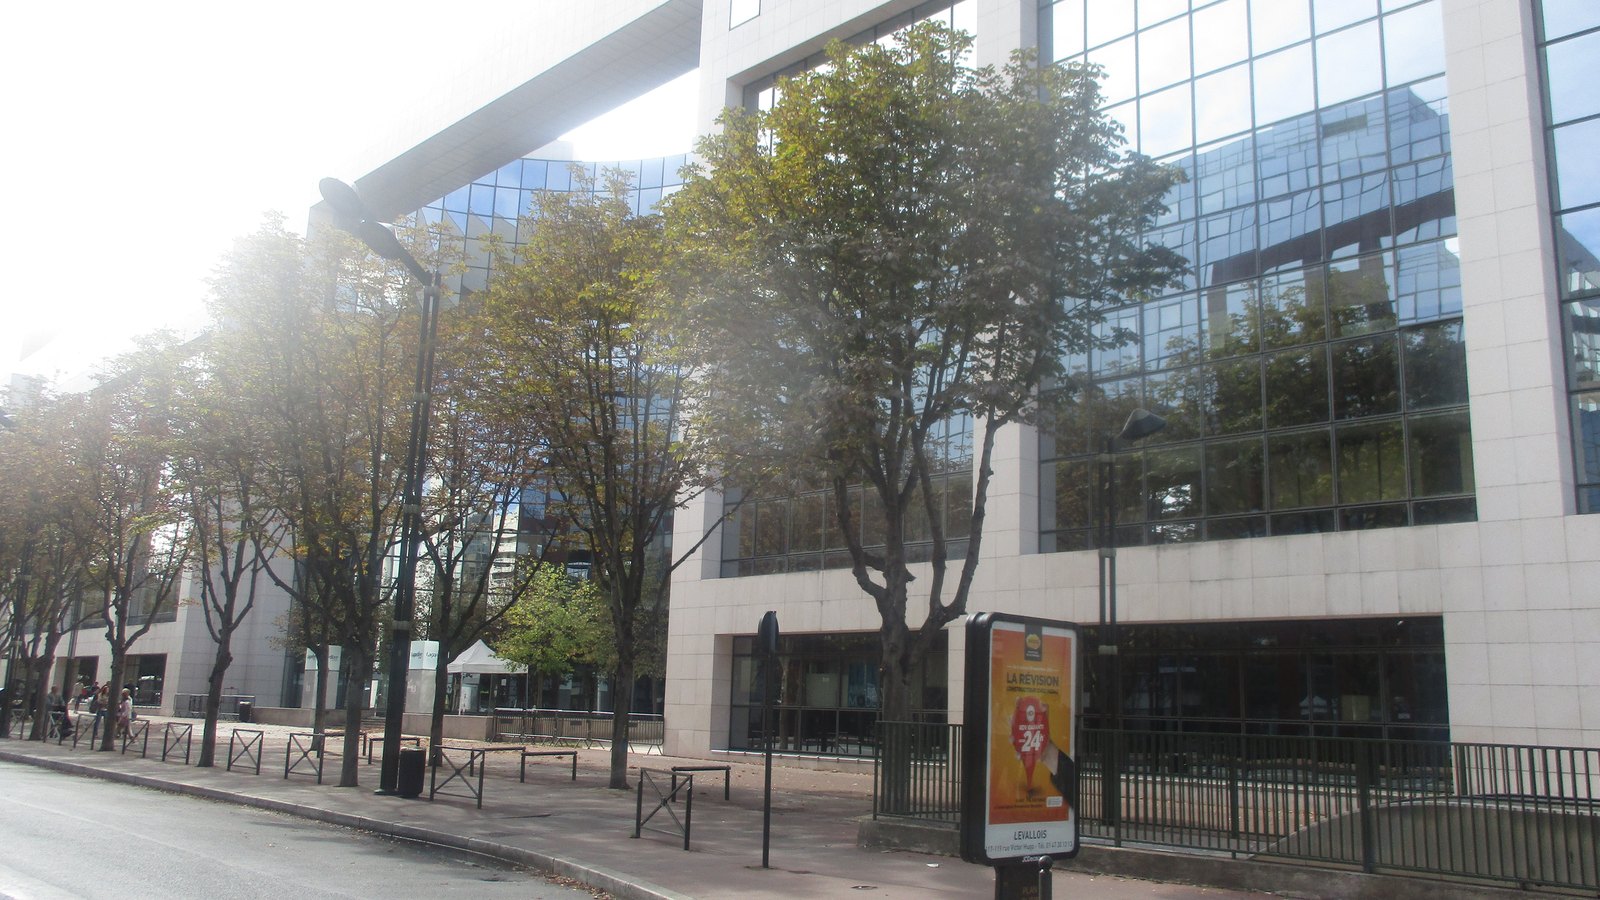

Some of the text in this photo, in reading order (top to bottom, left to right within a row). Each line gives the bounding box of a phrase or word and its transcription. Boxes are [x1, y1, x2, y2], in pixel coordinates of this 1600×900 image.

[1007, 672, 1059, 687] LA RÉVISION
[1013, 830, 1047, 840] LEVALLOIS
